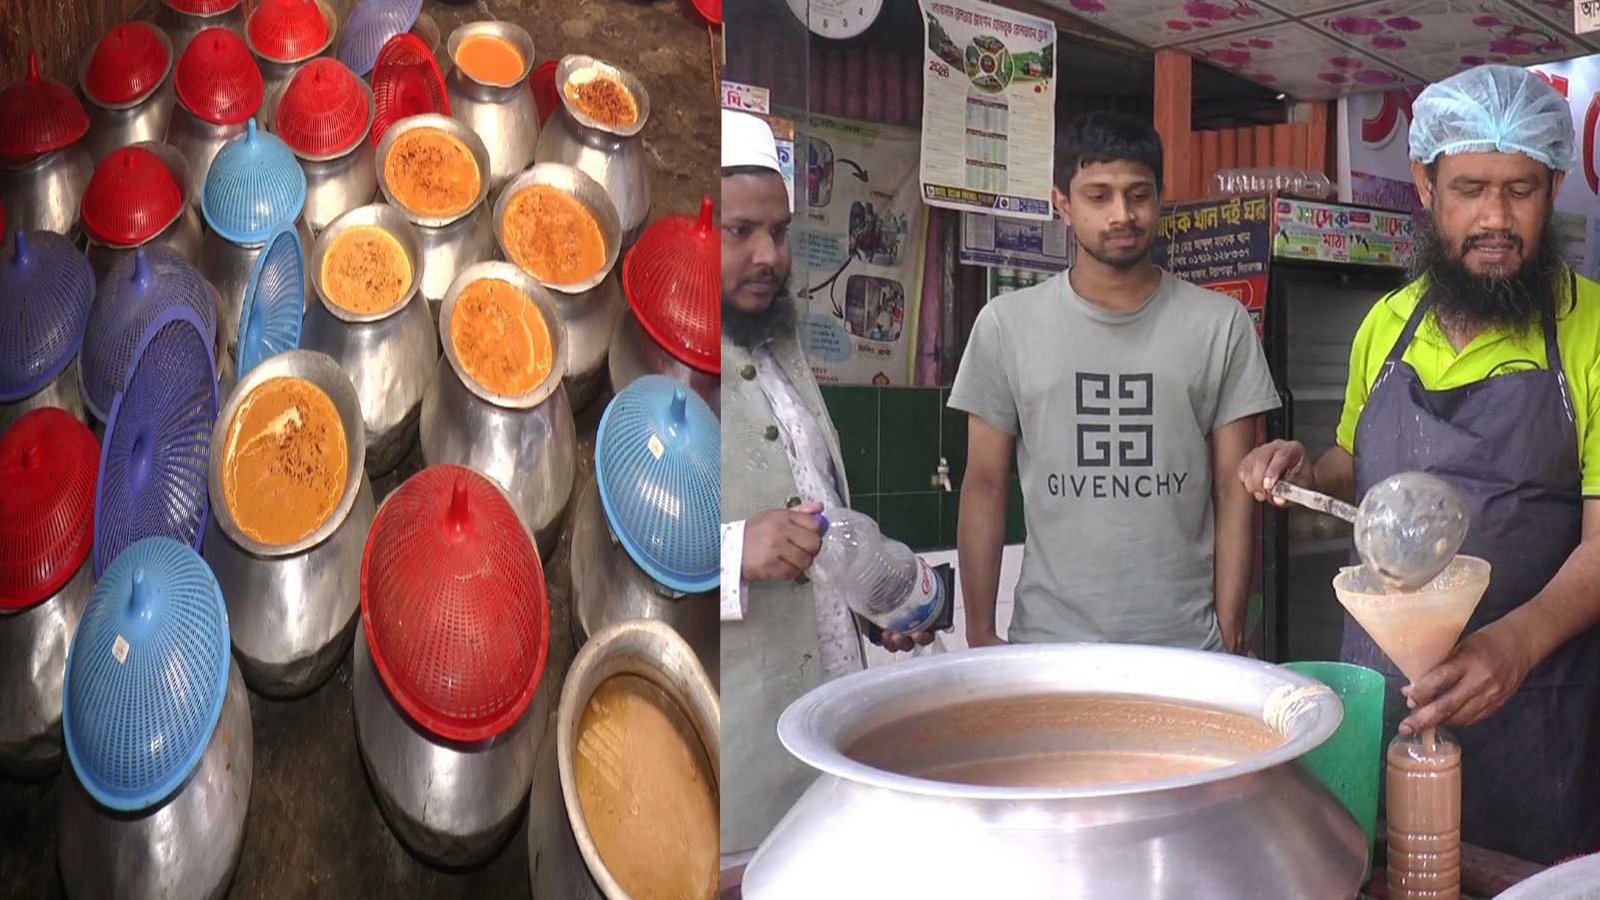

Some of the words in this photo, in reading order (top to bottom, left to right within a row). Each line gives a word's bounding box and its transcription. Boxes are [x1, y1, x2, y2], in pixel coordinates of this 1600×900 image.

[1159, 211, 1192, 240] াদেক
[1194, 206, 1218, 230] খান
[1221, 197, 1240, 225] দই
[1243, 198, 1266, 221] ঘর
[1047, 472, 1188, 499] GIVENCHY
